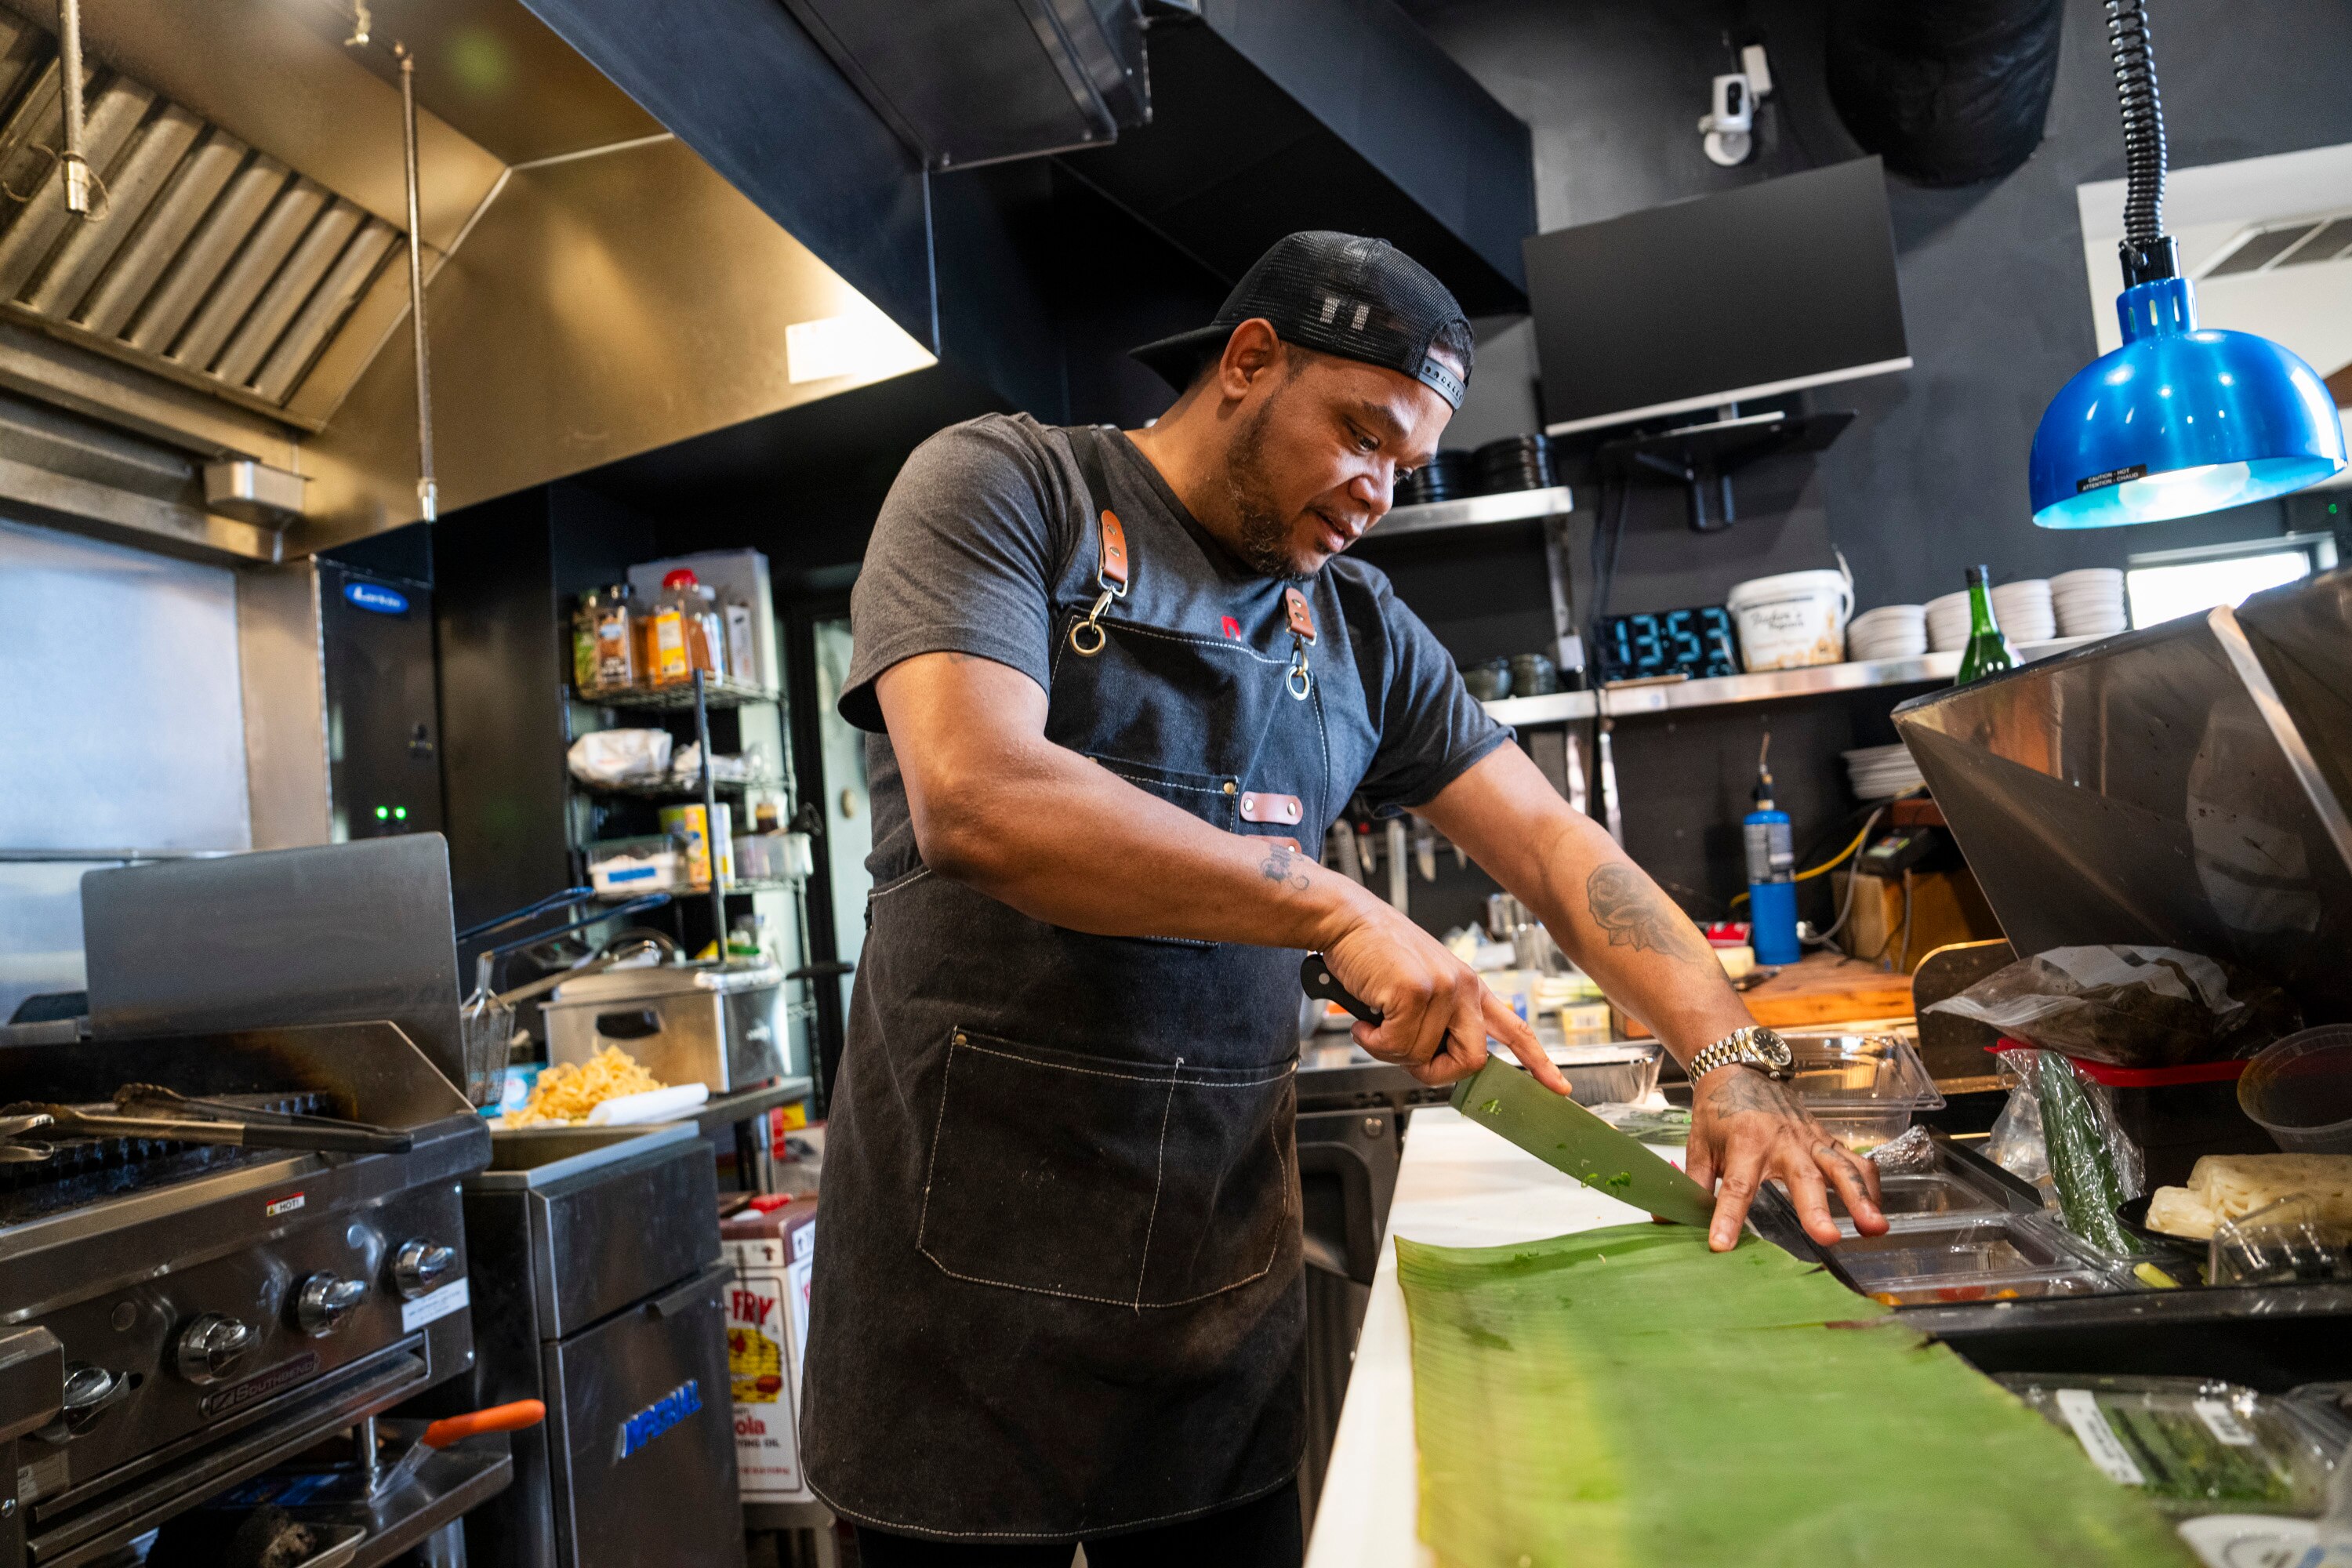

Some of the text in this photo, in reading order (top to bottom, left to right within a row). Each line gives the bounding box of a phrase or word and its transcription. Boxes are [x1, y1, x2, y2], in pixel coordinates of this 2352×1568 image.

[2082, 479, 2112, 492] ATTENTION
[2117, 472, 2138, 481] CHAUD
[2088, 472, 2112, 483] CAUTION
[1615, 607, 1733, 666] 13:53
[280, 1199, 299, 1210] HOT!
